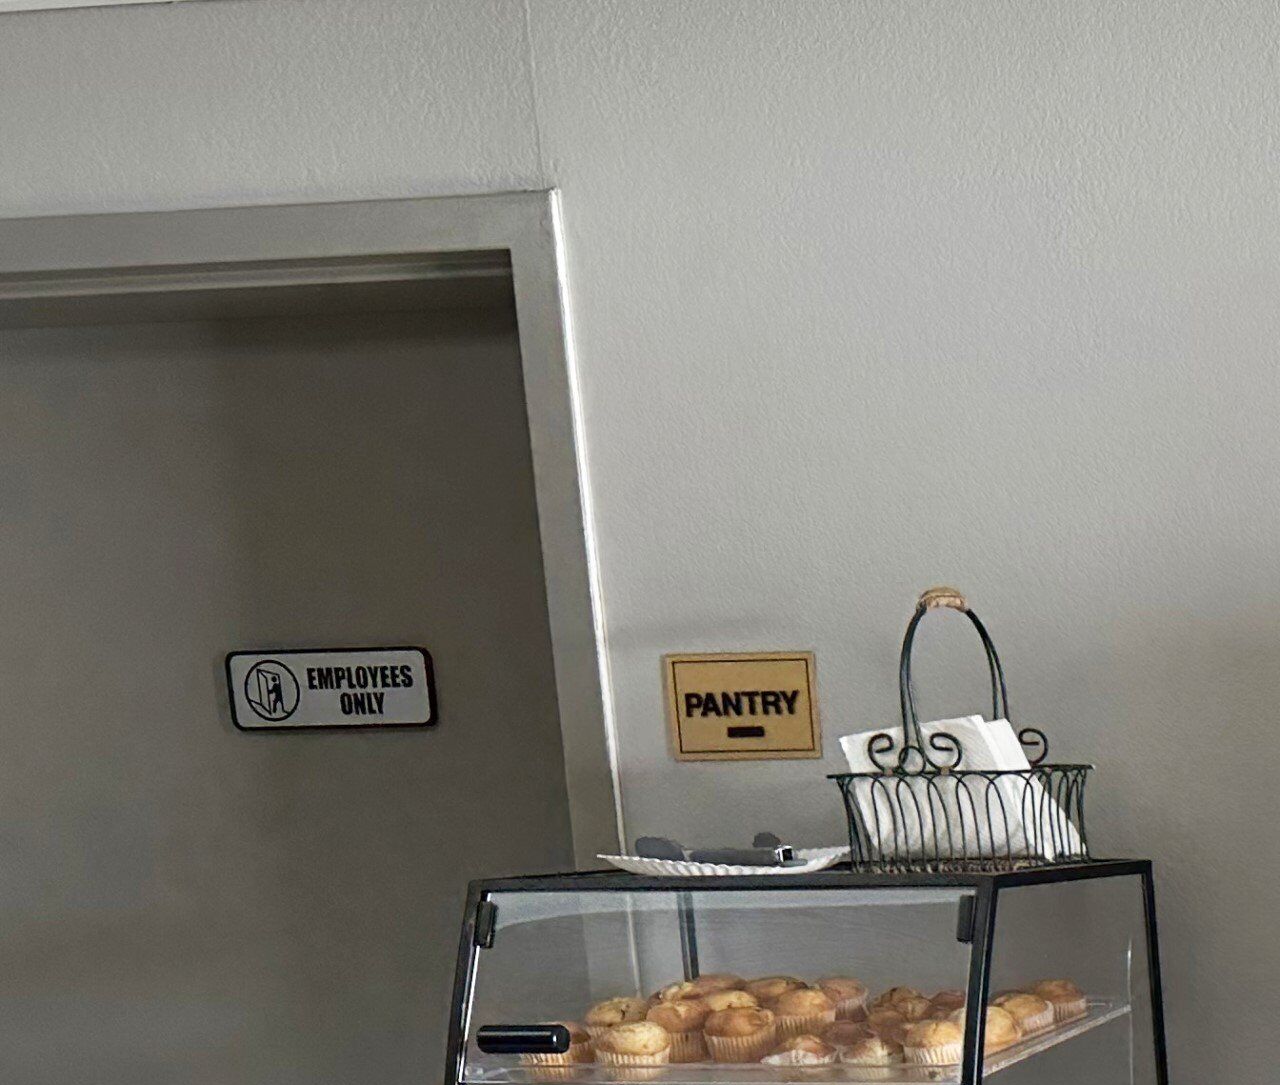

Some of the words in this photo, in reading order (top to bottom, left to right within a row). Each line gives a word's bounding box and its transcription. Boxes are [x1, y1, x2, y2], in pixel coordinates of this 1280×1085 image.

[306, 665, 414, 690] EMPLOYEES
[340, 692, 385, 715] ONLY
[684, 689, 800, 718] PANTRY
